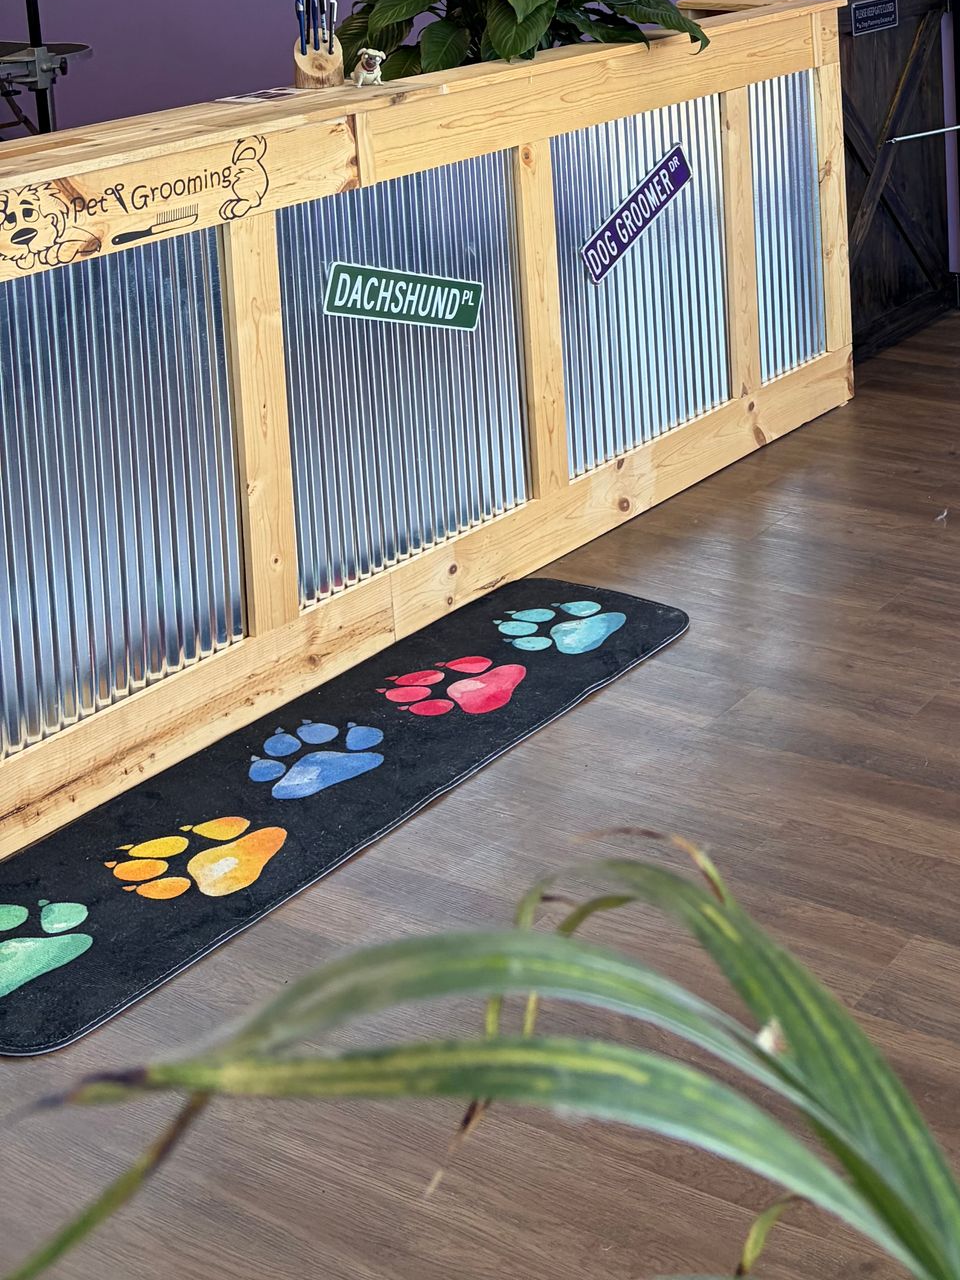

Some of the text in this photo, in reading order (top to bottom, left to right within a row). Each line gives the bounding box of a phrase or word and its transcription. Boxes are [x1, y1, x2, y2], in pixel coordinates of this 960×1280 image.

[70, 166, 232, 223] Pet Grooming
[587, 156, 680, 275] DOG GROOMER DR
[334, 273, 475, 320] DACHSHUND PL
